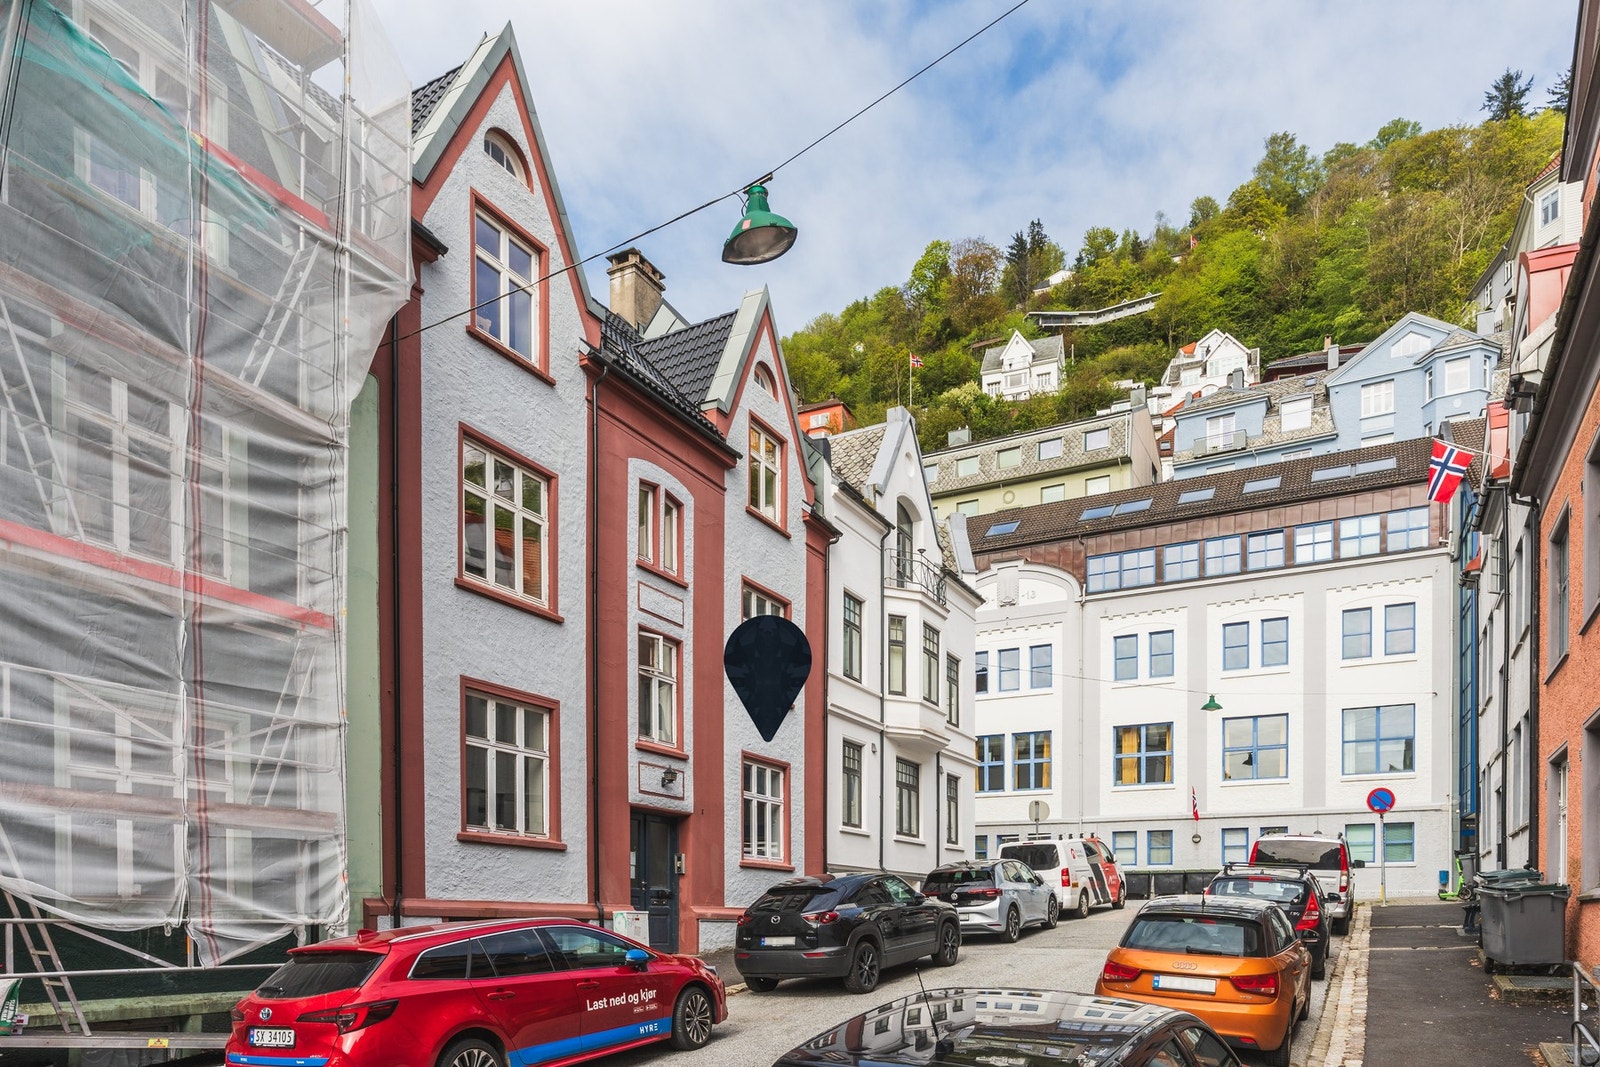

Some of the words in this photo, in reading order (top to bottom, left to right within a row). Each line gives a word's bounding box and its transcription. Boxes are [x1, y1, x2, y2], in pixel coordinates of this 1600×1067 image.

[586, 997, 608, 1011] Last
[609, 992, 626, 1007] ned
[627, 993, 639, 1004] og
[640, 988, 657, 1003] kjør
[639, 1023, 659, 1035] HYRE
[255, 1030, 265, 1042] SX
[268, 1031, 292, 1043] 34105
